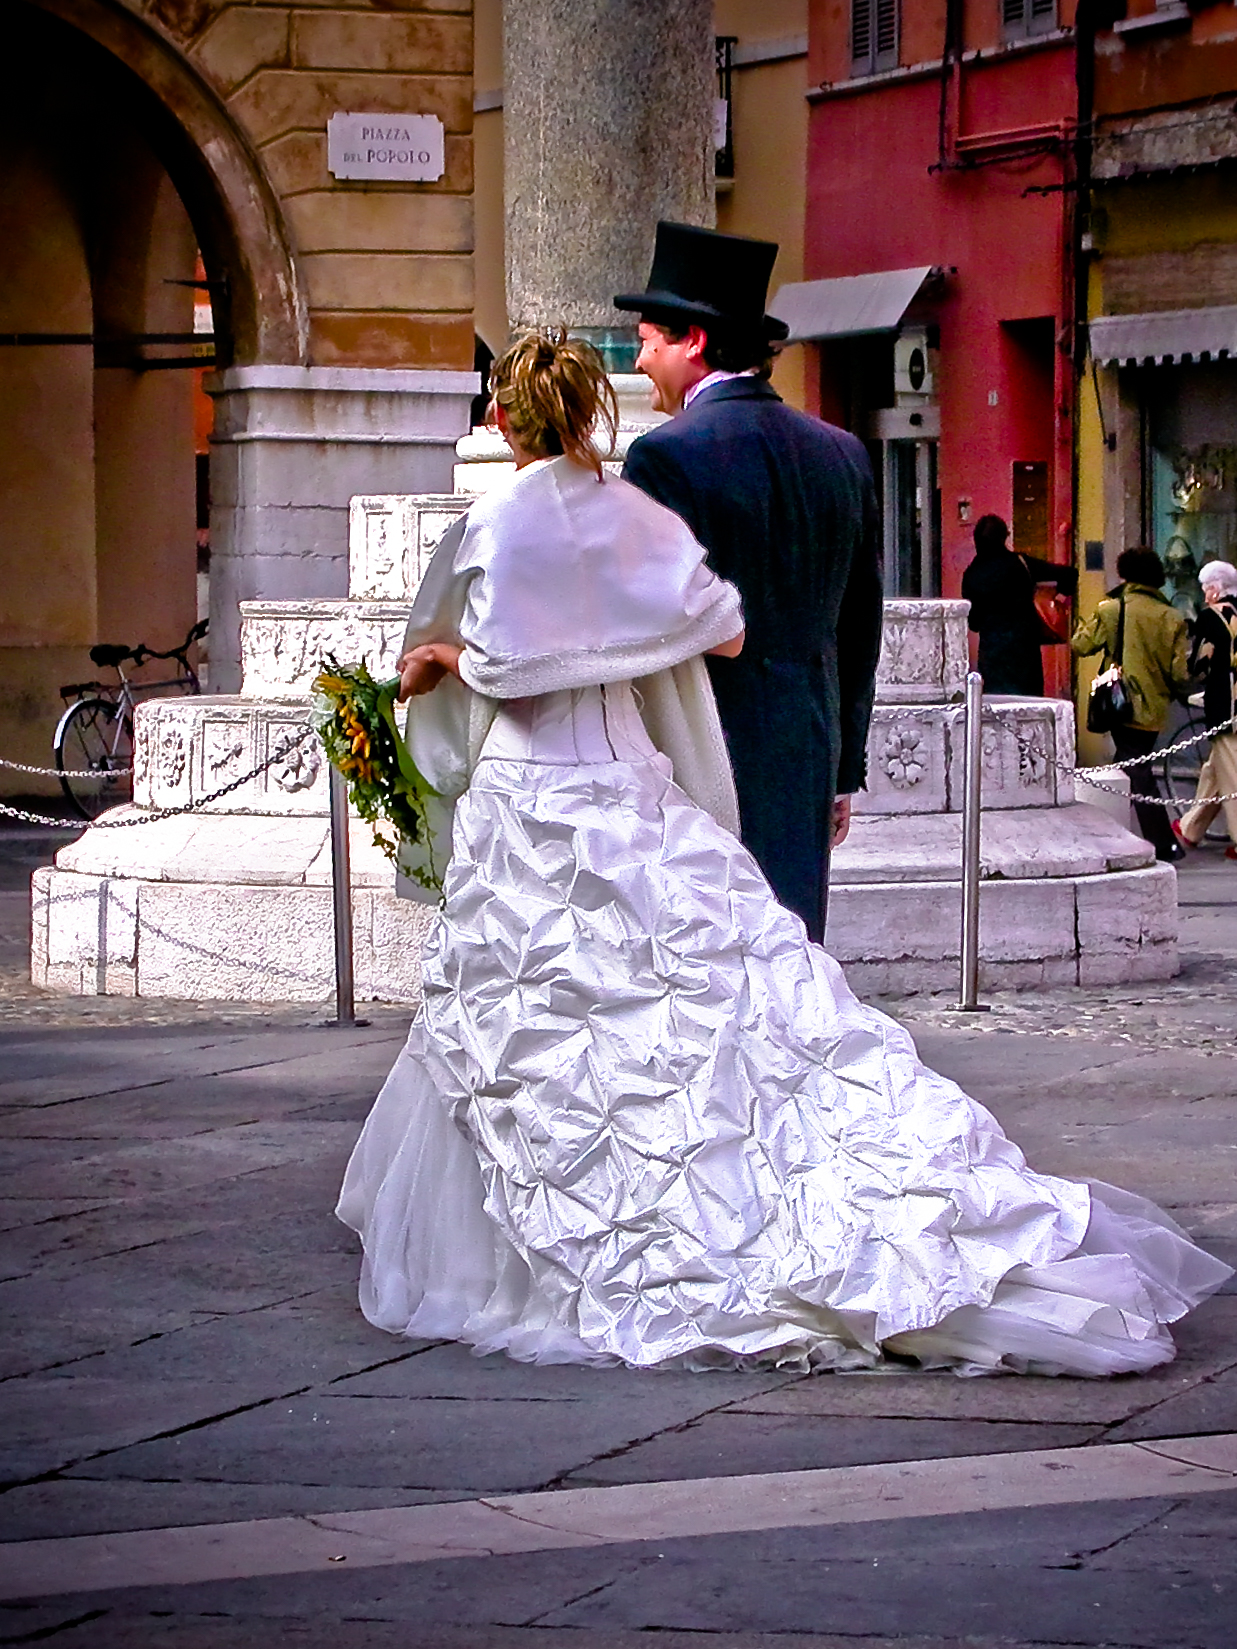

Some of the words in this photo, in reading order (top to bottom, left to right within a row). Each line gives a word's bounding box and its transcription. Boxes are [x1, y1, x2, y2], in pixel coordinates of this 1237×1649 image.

[362, 127, 410, 141] PIAZZA
[343, 152, 363, 163] DEL
[367, 148, 431, 164] POPOLO
